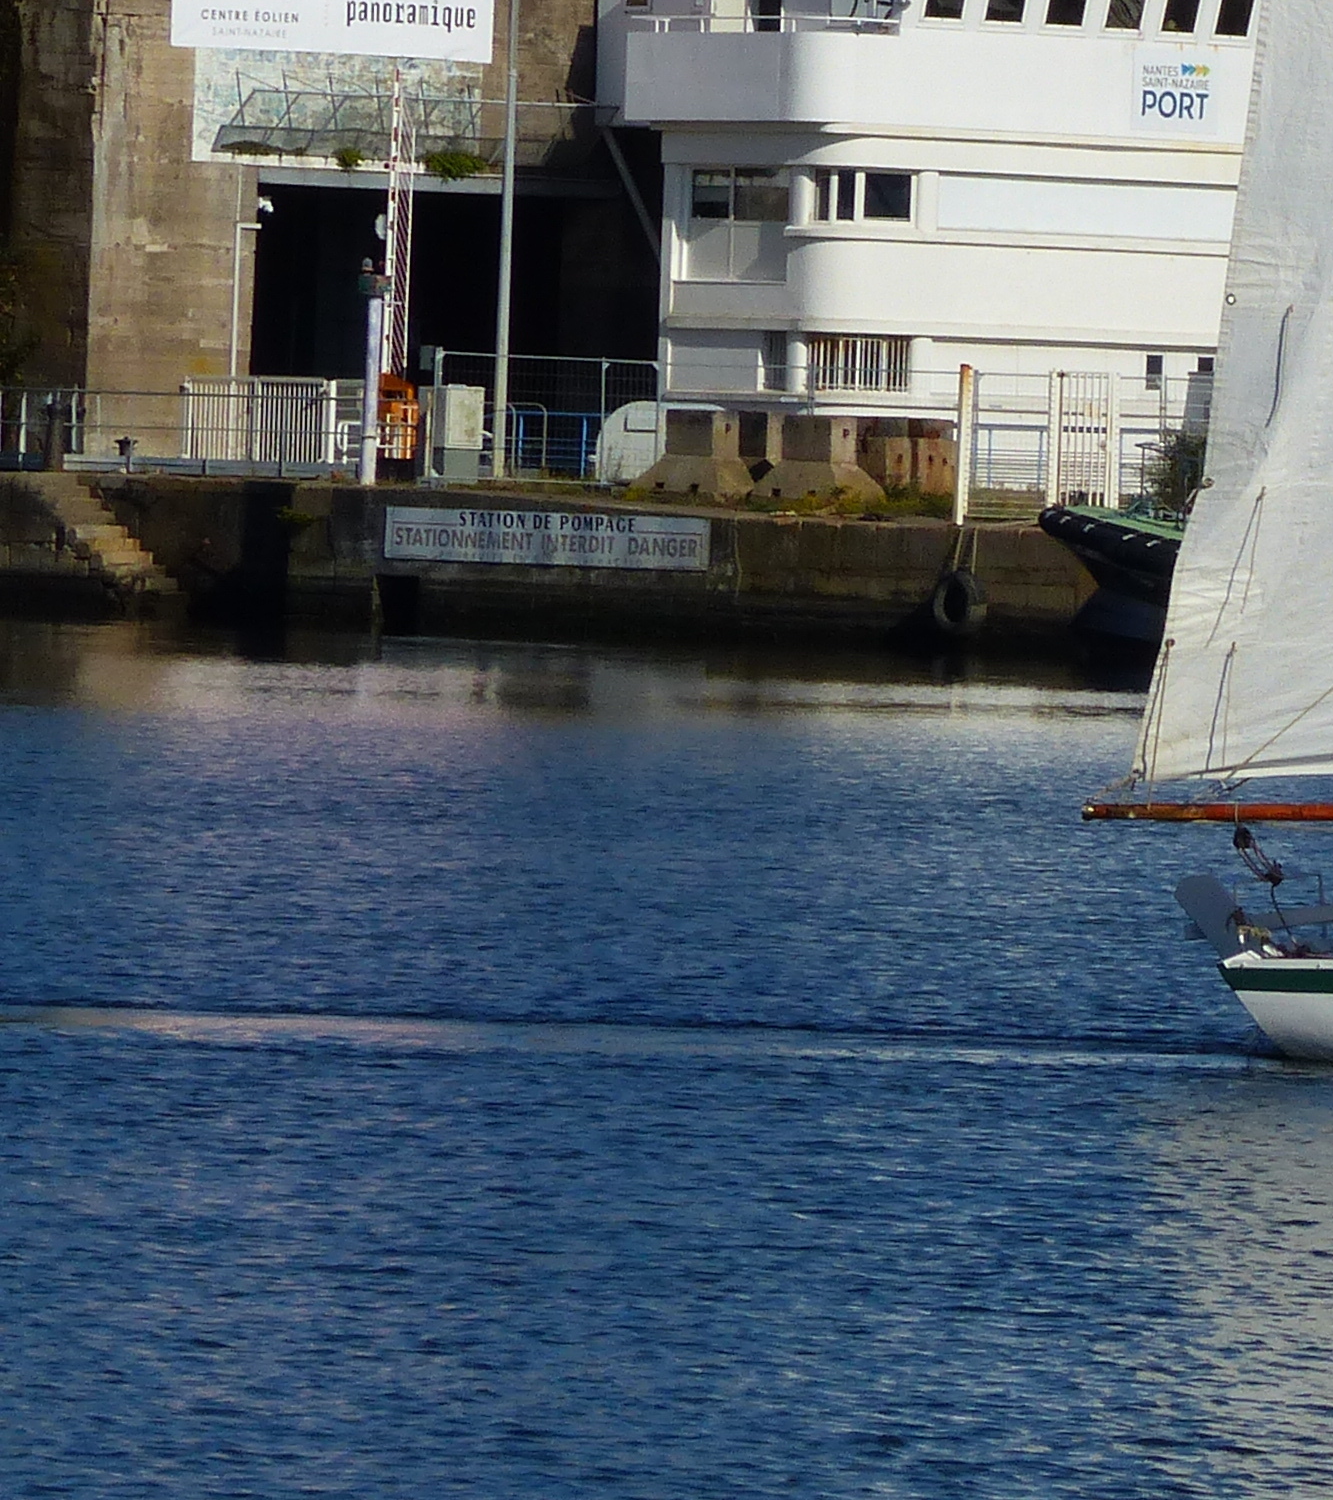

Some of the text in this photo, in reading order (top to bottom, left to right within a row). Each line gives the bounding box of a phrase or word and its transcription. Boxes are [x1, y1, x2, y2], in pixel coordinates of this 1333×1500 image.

[201, 8, 299, 23] CENTRE ÉOLIEN
[346, 0, 476, 33] panoramique
[1142, 65, 1179, 77] NANTES
[1142, 76, 1210, 90] SAINT-NAZAIRE
[1141, 90, 1209, 120] PORT
[459, 511, 637, 533] STATION DE POMPAGE
[394, 527, 698, 558] STATIONNEMENT INTERDIT DANGER
